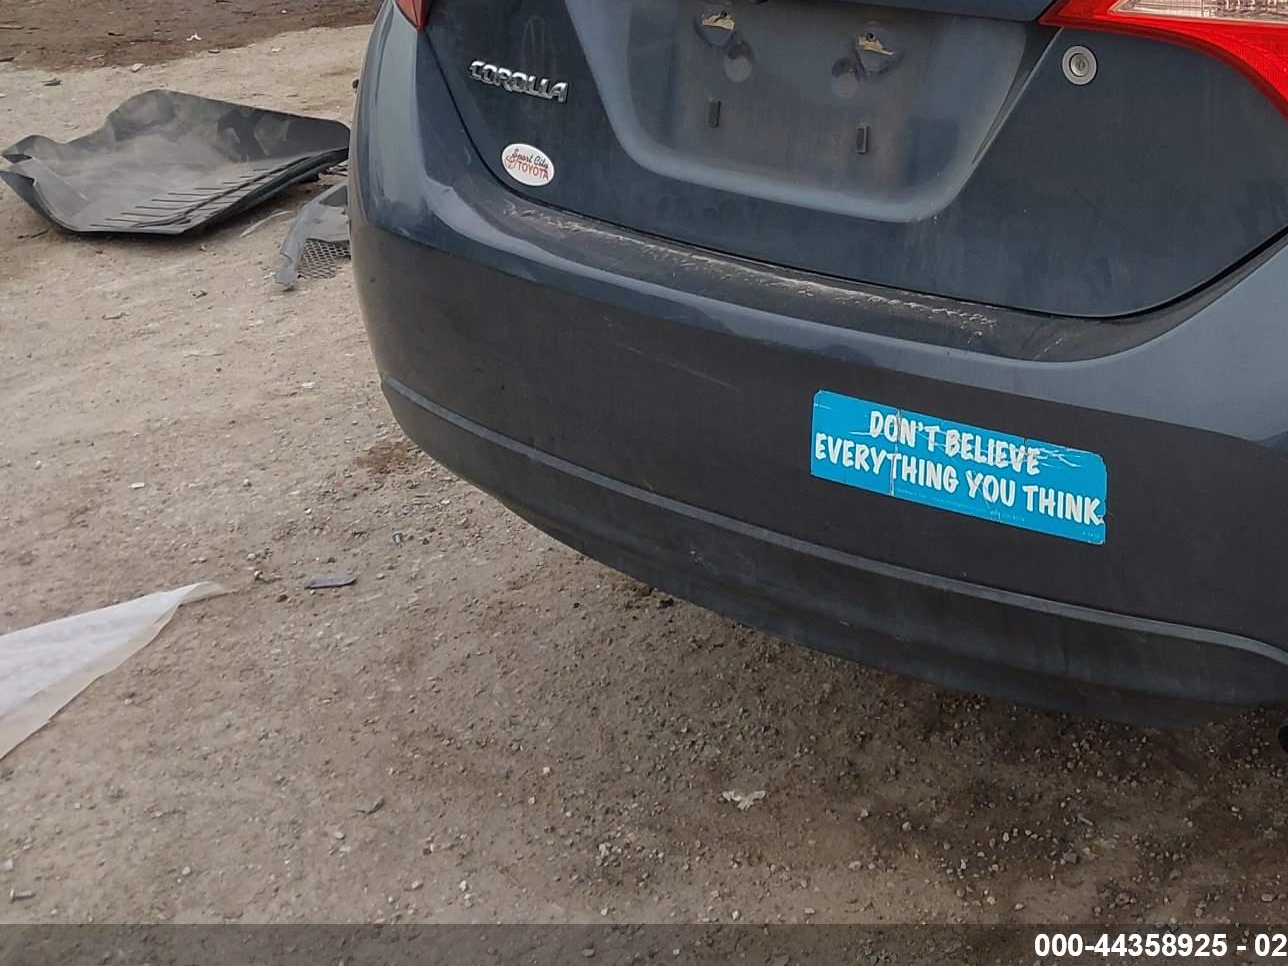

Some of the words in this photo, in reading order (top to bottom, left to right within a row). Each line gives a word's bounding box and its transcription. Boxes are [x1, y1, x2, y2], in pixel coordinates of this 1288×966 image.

[469, 60, 568, 102] COROLLA
[512, 148, 534, 163] Sport
[534, 155, 549, 170] City
[517, 161, 549, 180] TOYOTA
[869, 410, 939, 451] DON'T
[945, 430, 1041, 476] BELIEVE
[815, 432, 958, 492] EVERYTHING
[966, 470, 1016, 507] YOU
[1022, 485, 1104, 526] THINK
